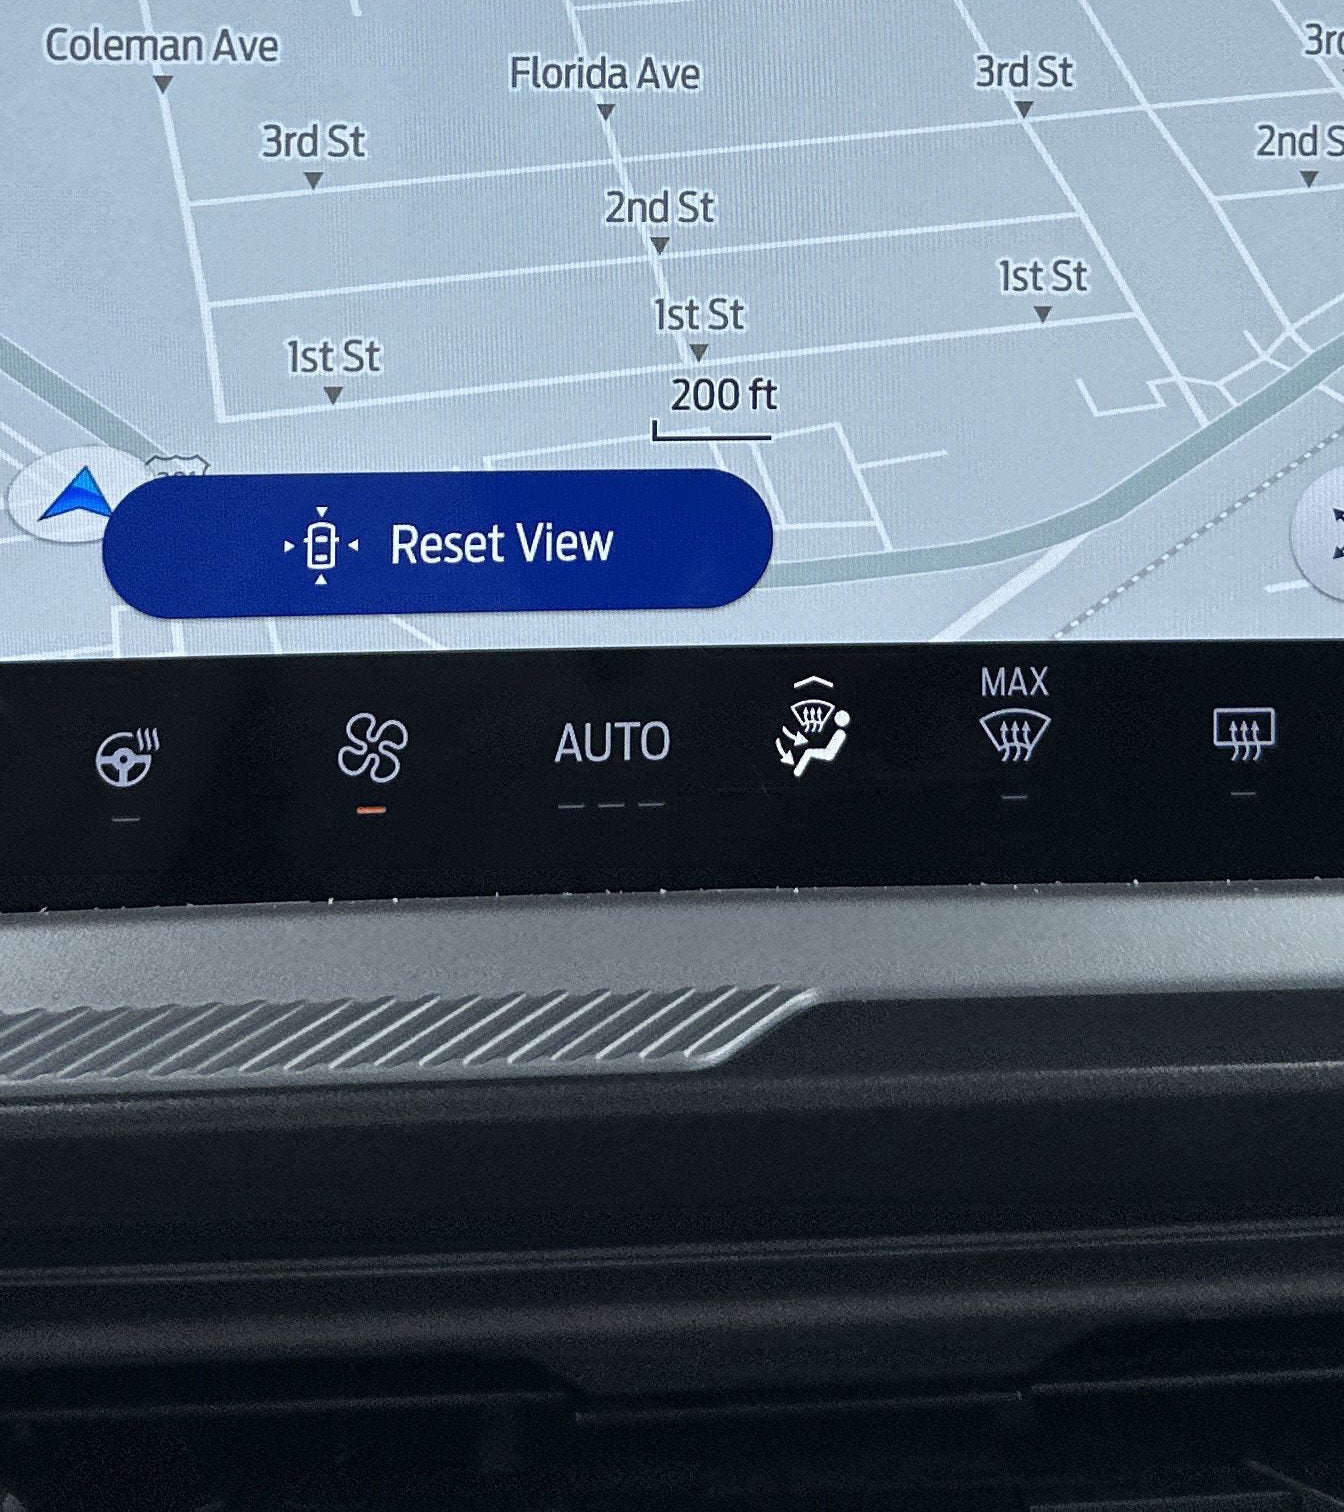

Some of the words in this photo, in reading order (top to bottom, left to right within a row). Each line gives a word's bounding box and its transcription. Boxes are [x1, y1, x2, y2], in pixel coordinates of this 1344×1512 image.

[46, 26, 203, 62] Coleman
[212, 28, 280, 63] Ave
[510, 56, 628, 90] Florida
[637, 58, 701, 91] Ave
[975, 54, 1029, 87] 3rd
[1037, 55, 1073, 88] St
[261, 124, 319, 158] 3rd
[327, 125, 366, 158] St
[1256, 124, 1319, 156] 2nd
[605, 189, 670, 223] 2nd
[677, 191, 715, 224] St
[999, 259, 1044, 291] 1st
[1051, 259, 1088, 291] St
[654, 297, 701, 331] 1st
[708, 298, 745, 331] St
[287, 338, 334, 373] 1st
[343, 339, 381, 373] St
[671, 377, 739, 411] 200
[748, 377, 778, 411] ft
[391, 523, 505, 566] Reset
[515, 521, 615, 563] View
[980, 666, 1049, 697] MAX
[554, 720, 671, 764] AUTO
